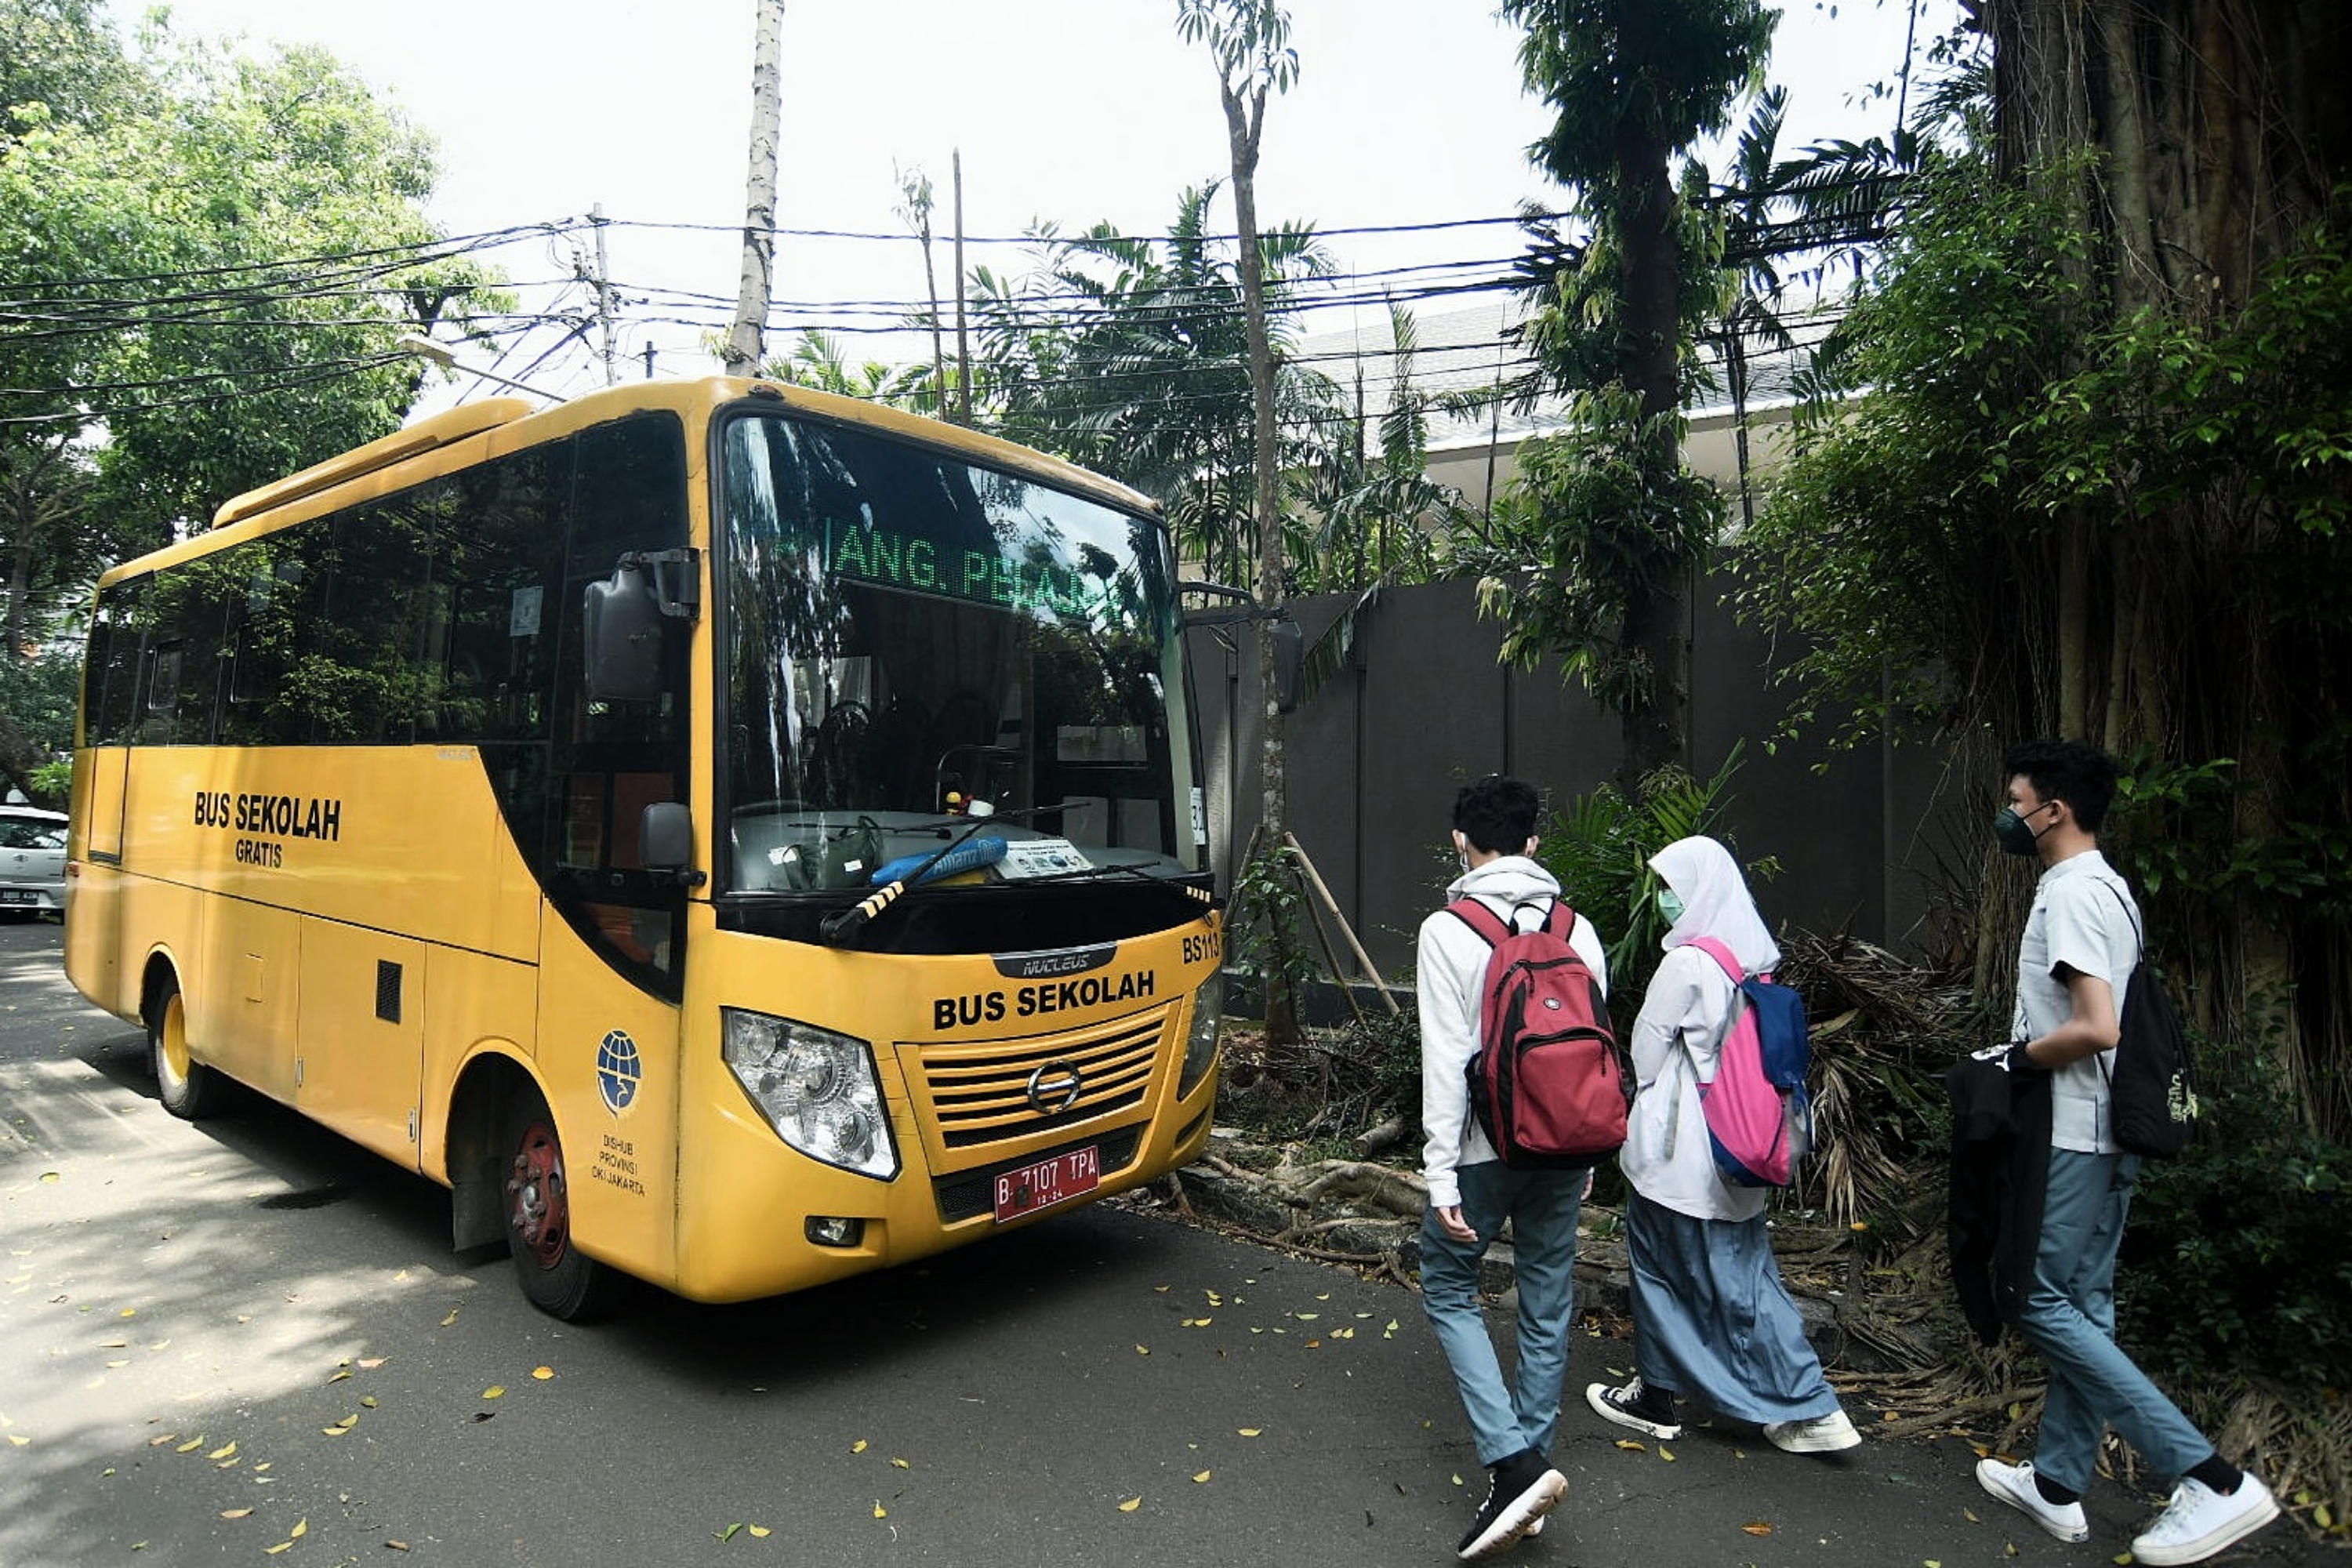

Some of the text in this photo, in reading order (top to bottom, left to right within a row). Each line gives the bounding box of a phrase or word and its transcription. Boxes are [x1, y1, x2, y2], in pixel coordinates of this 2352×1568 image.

[195, 791, 341, 842] BUS SEKOLAH
[235, 838, 283, 869] GRATIS
[1183, 931, 1219, 965] BS113
[1022, 953, 1091, 976] NUCLEUS
[934, 970, 1154, 1031] BUS SEKOLAH
[598, 1150, 638, 1176] PROVINSI
[1022, 1161, 1058, 1193] 7107
[1069, 1149, 1096, 1181] TPA
[607, 1172, 645, 1198] JAKARTA
